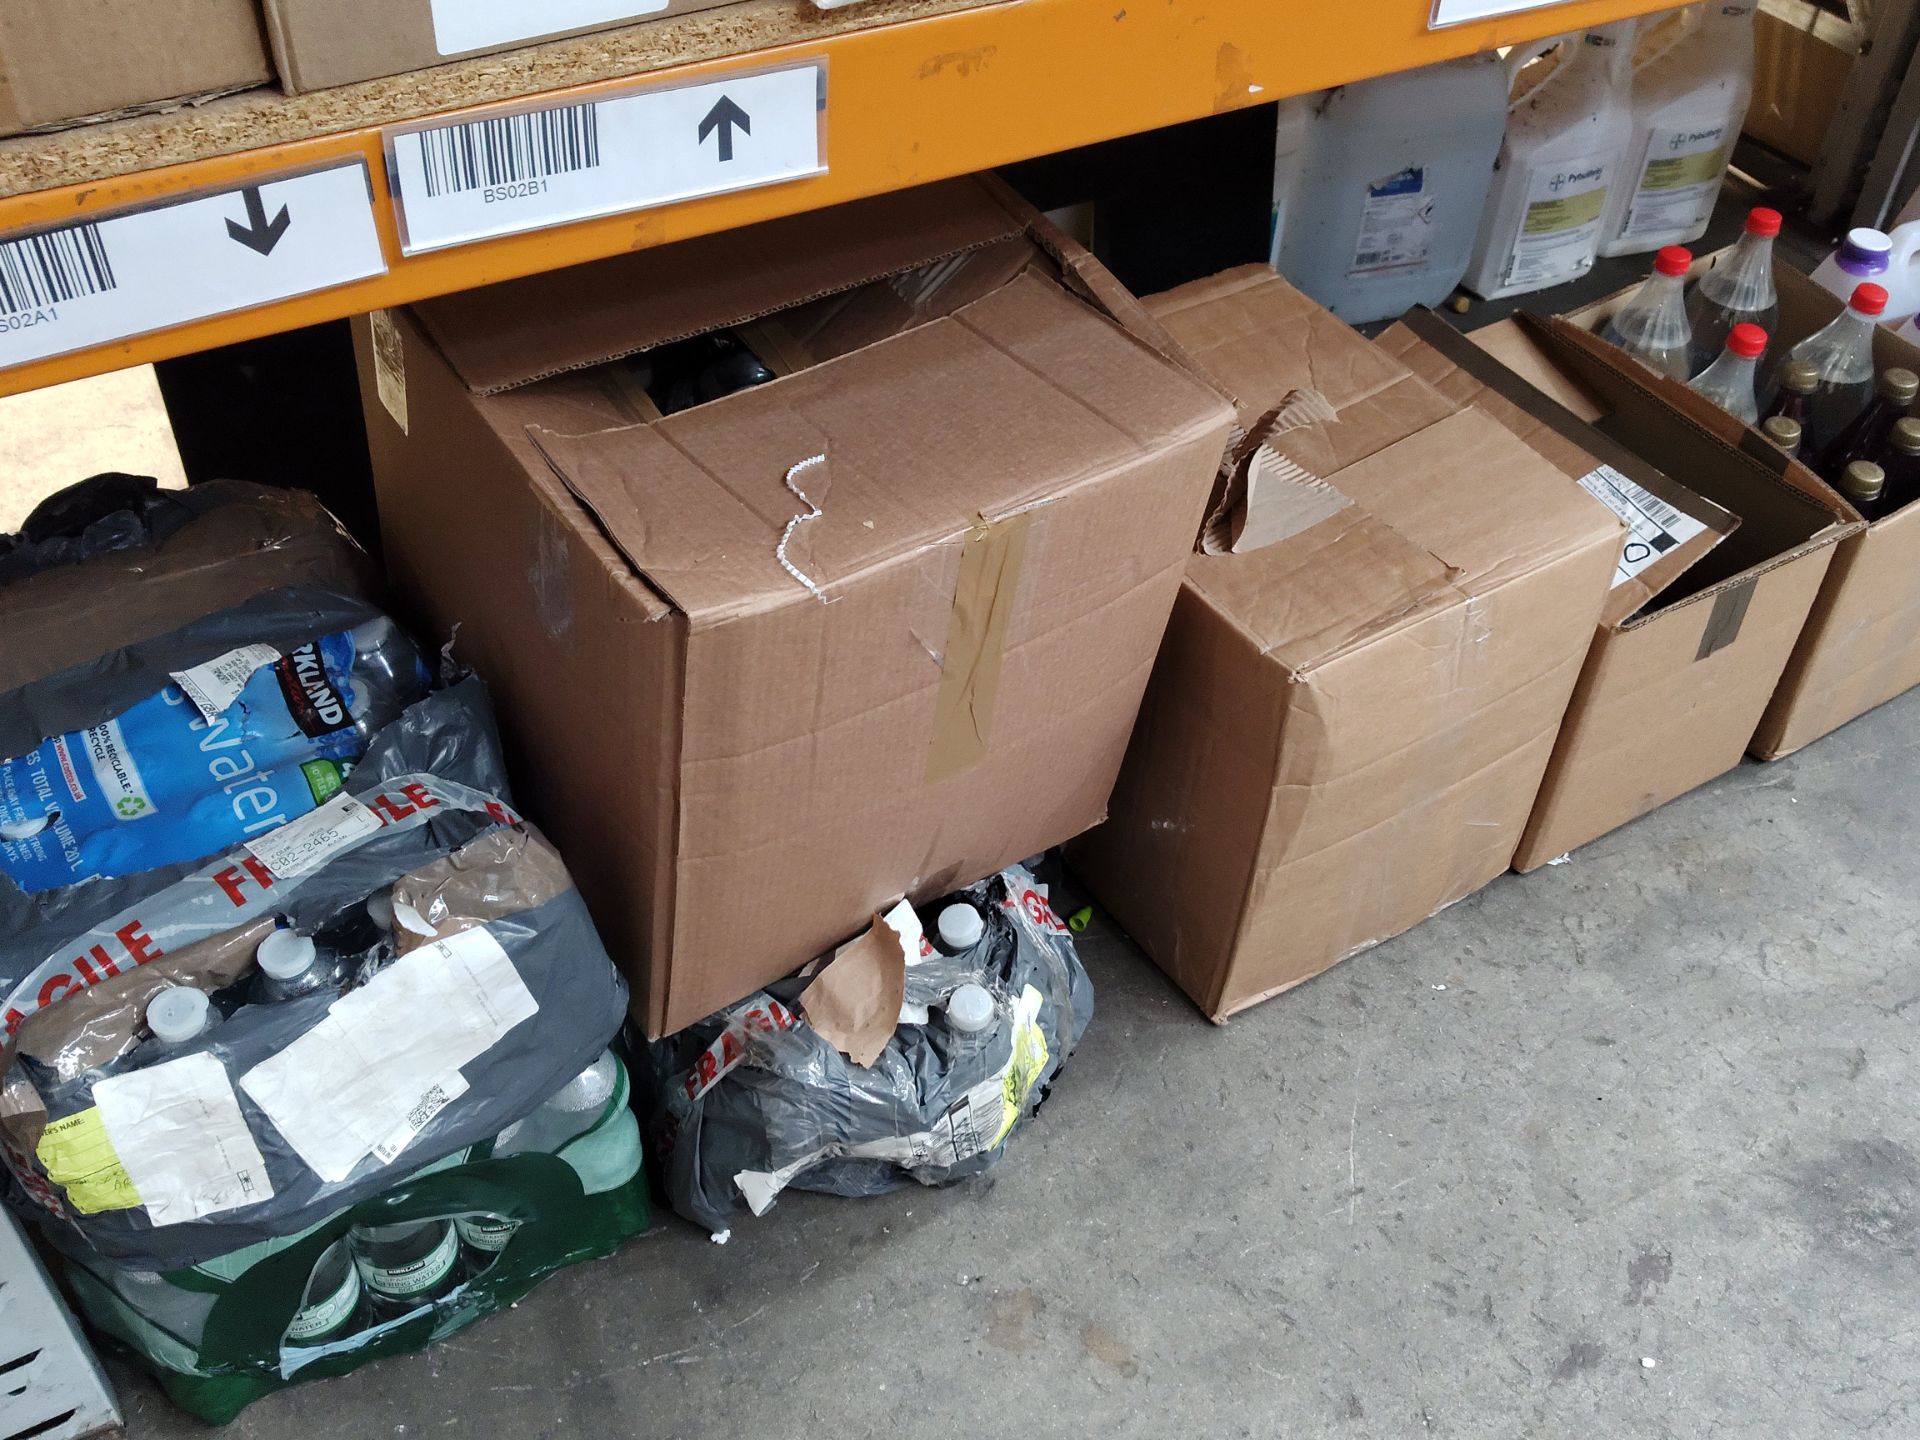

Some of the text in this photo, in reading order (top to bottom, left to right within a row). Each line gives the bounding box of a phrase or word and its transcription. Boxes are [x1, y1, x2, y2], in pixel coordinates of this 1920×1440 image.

[483, 179, 548, 204] BS02B1
[56, 743, 84, 800] www.costco.co.uk
[30, 767, 54, 802] TOTAL
[59, 1118, 85, 1132] NAME:
[388, 1261, 425, 1275] KIRKLAND
[413, 1264, 441, 1285] WATER
